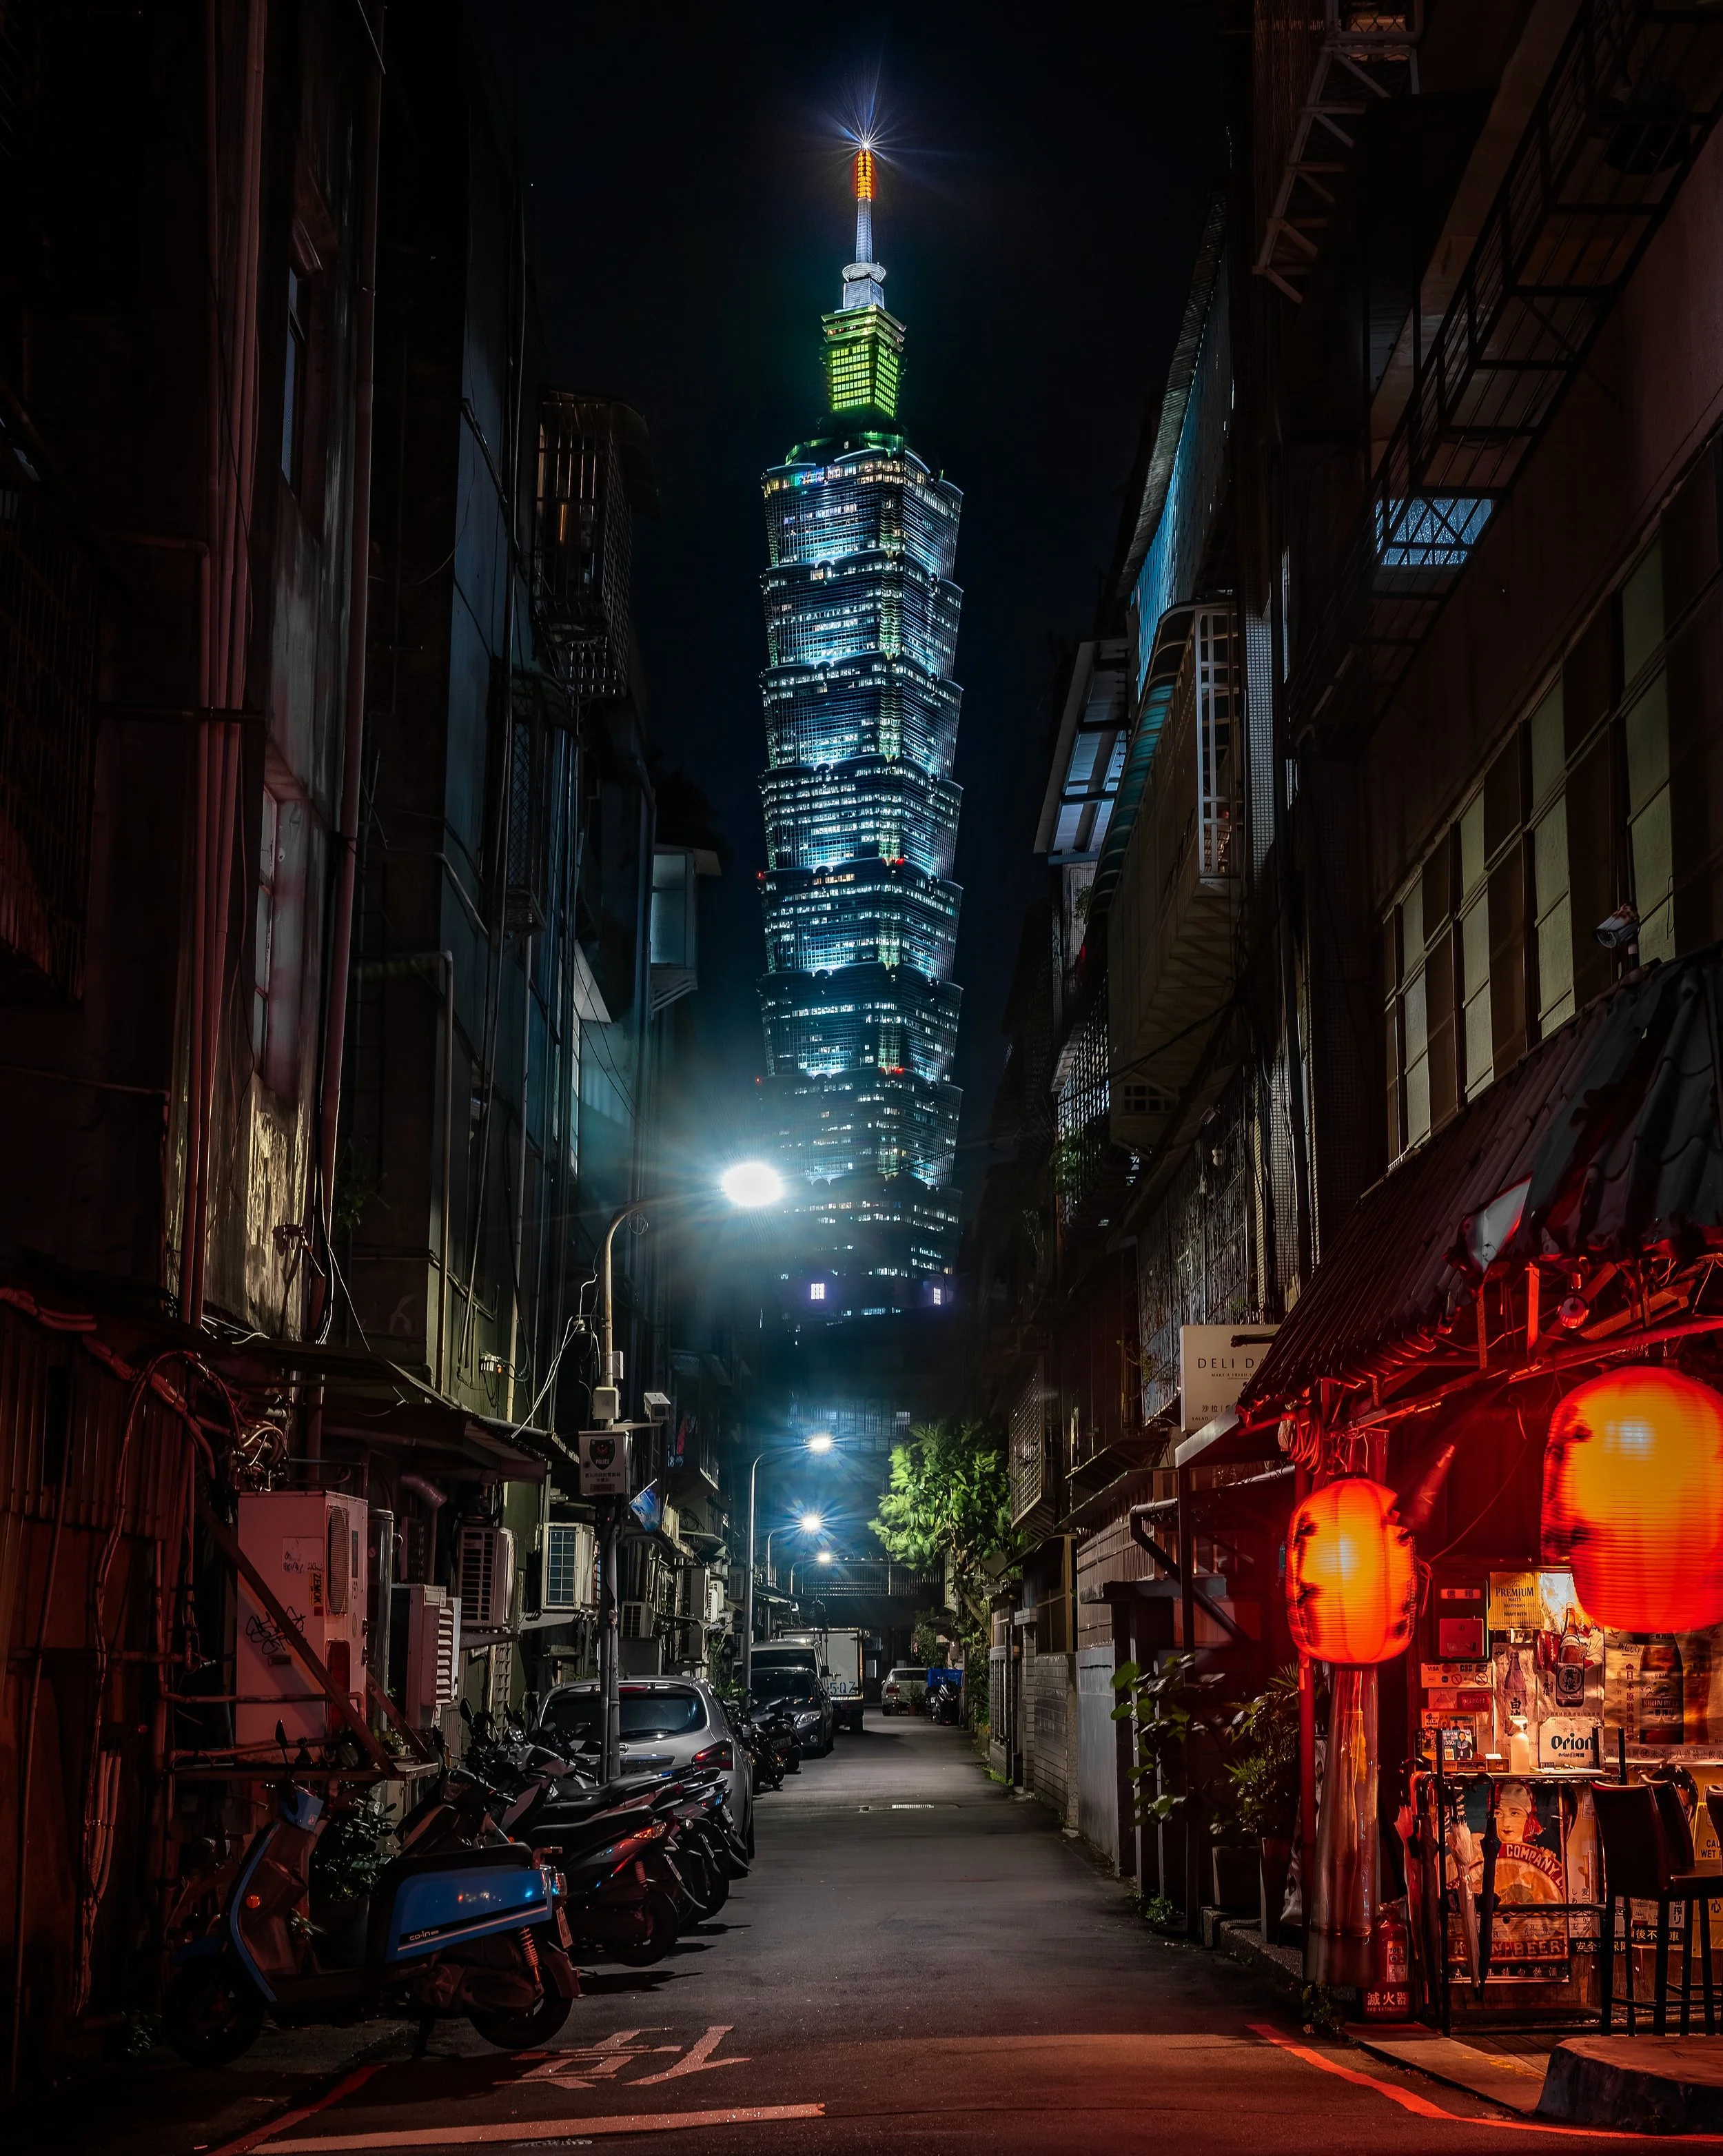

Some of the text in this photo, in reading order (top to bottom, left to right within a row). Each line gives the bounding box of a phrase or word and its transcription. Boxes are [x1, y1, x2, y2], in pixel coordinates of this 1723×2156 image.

[1198, 1358, 1234, 1369] DELI
[1496, 1586, 1534, 1597] PREMIUM
[1551, 1732, 1593, 1750] Orion
[1700, 1849, 1716, 1858] WET
[1513, 1940, 1560, 1955] BEER
[1367, 1991, 1409, 2006] 滅火器
